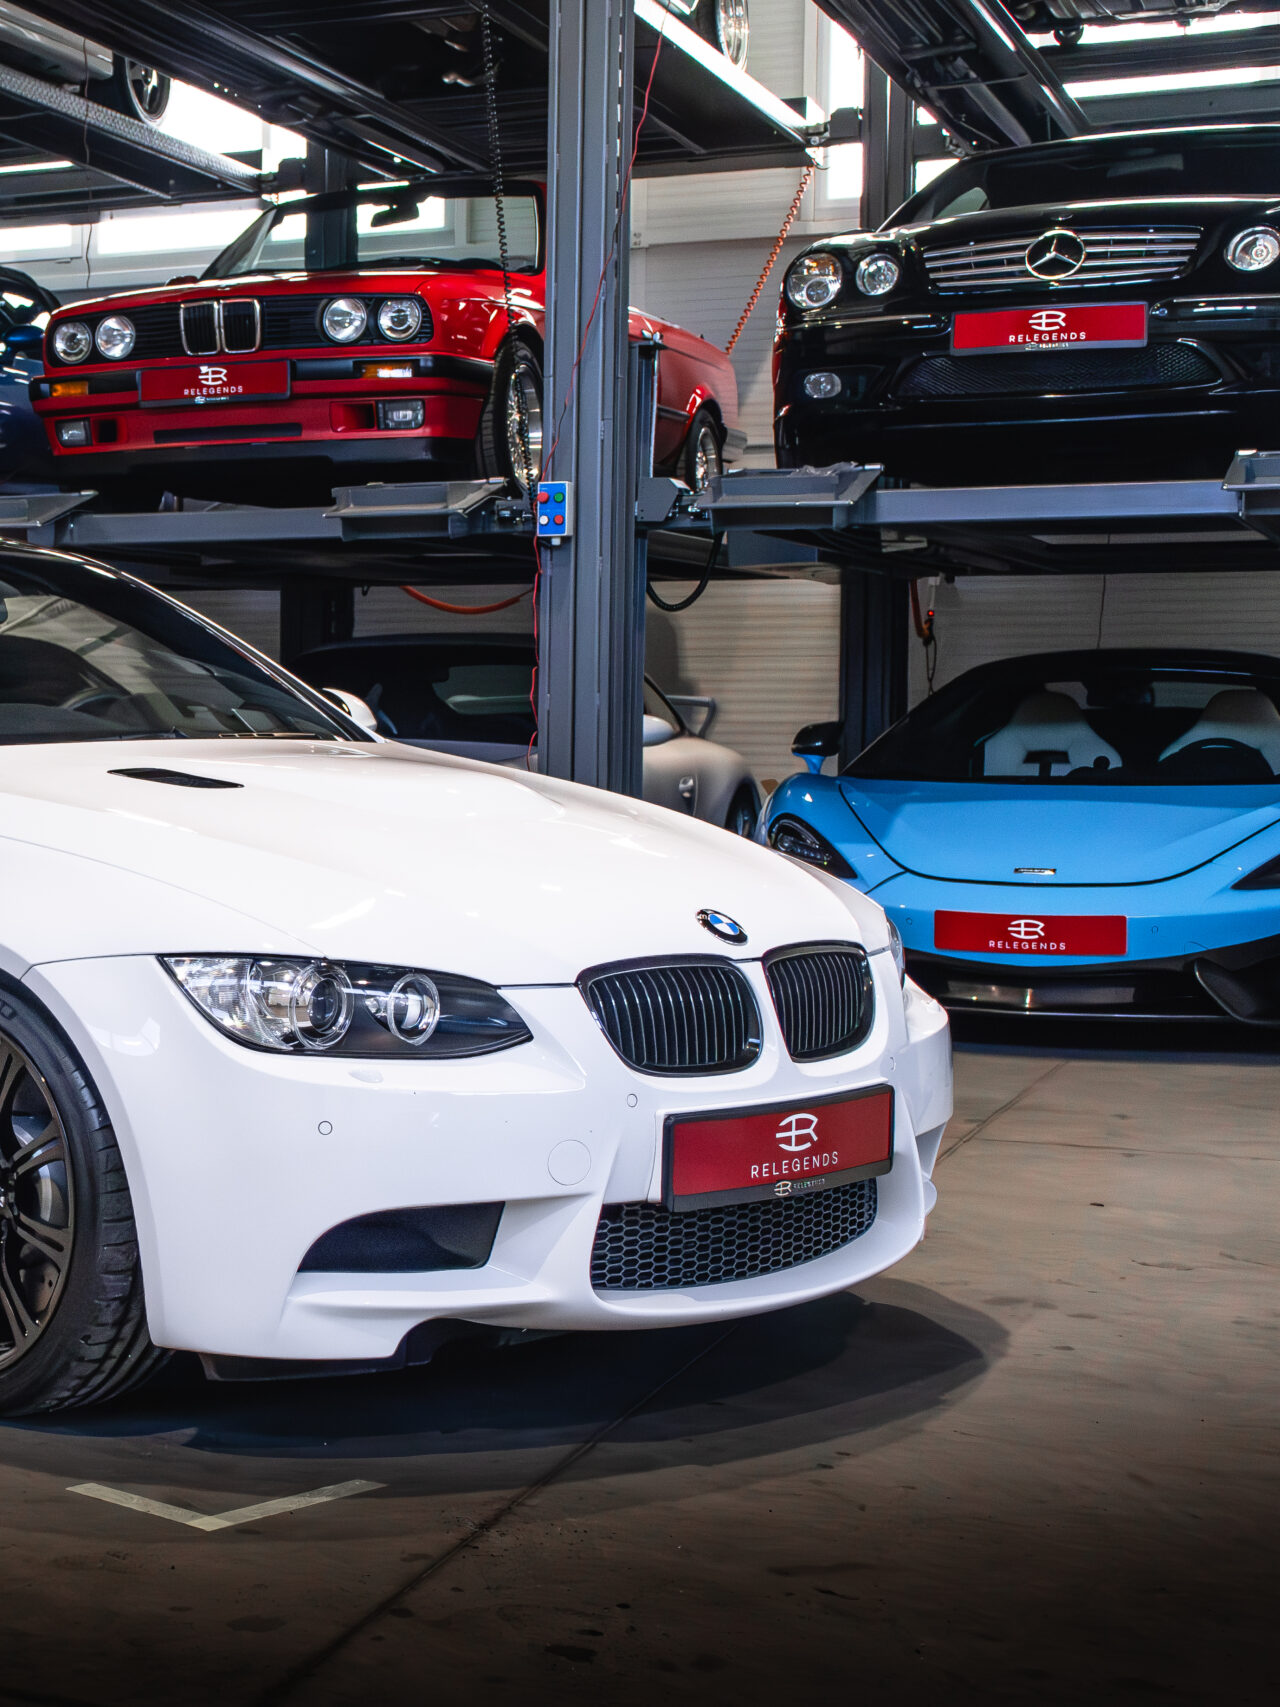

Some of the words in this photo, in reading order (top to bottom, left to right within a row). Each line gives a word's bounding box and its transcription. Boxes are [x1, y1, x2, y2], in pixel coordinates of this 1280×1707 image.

[1009, 332, 1087, 343] RELEGENDS
[184, 385, 243, 396] RELEGENDS
[989, 940, 1066, 951] RELEGENDS
[751, 1151, 839, 1179] RELEGENDS
